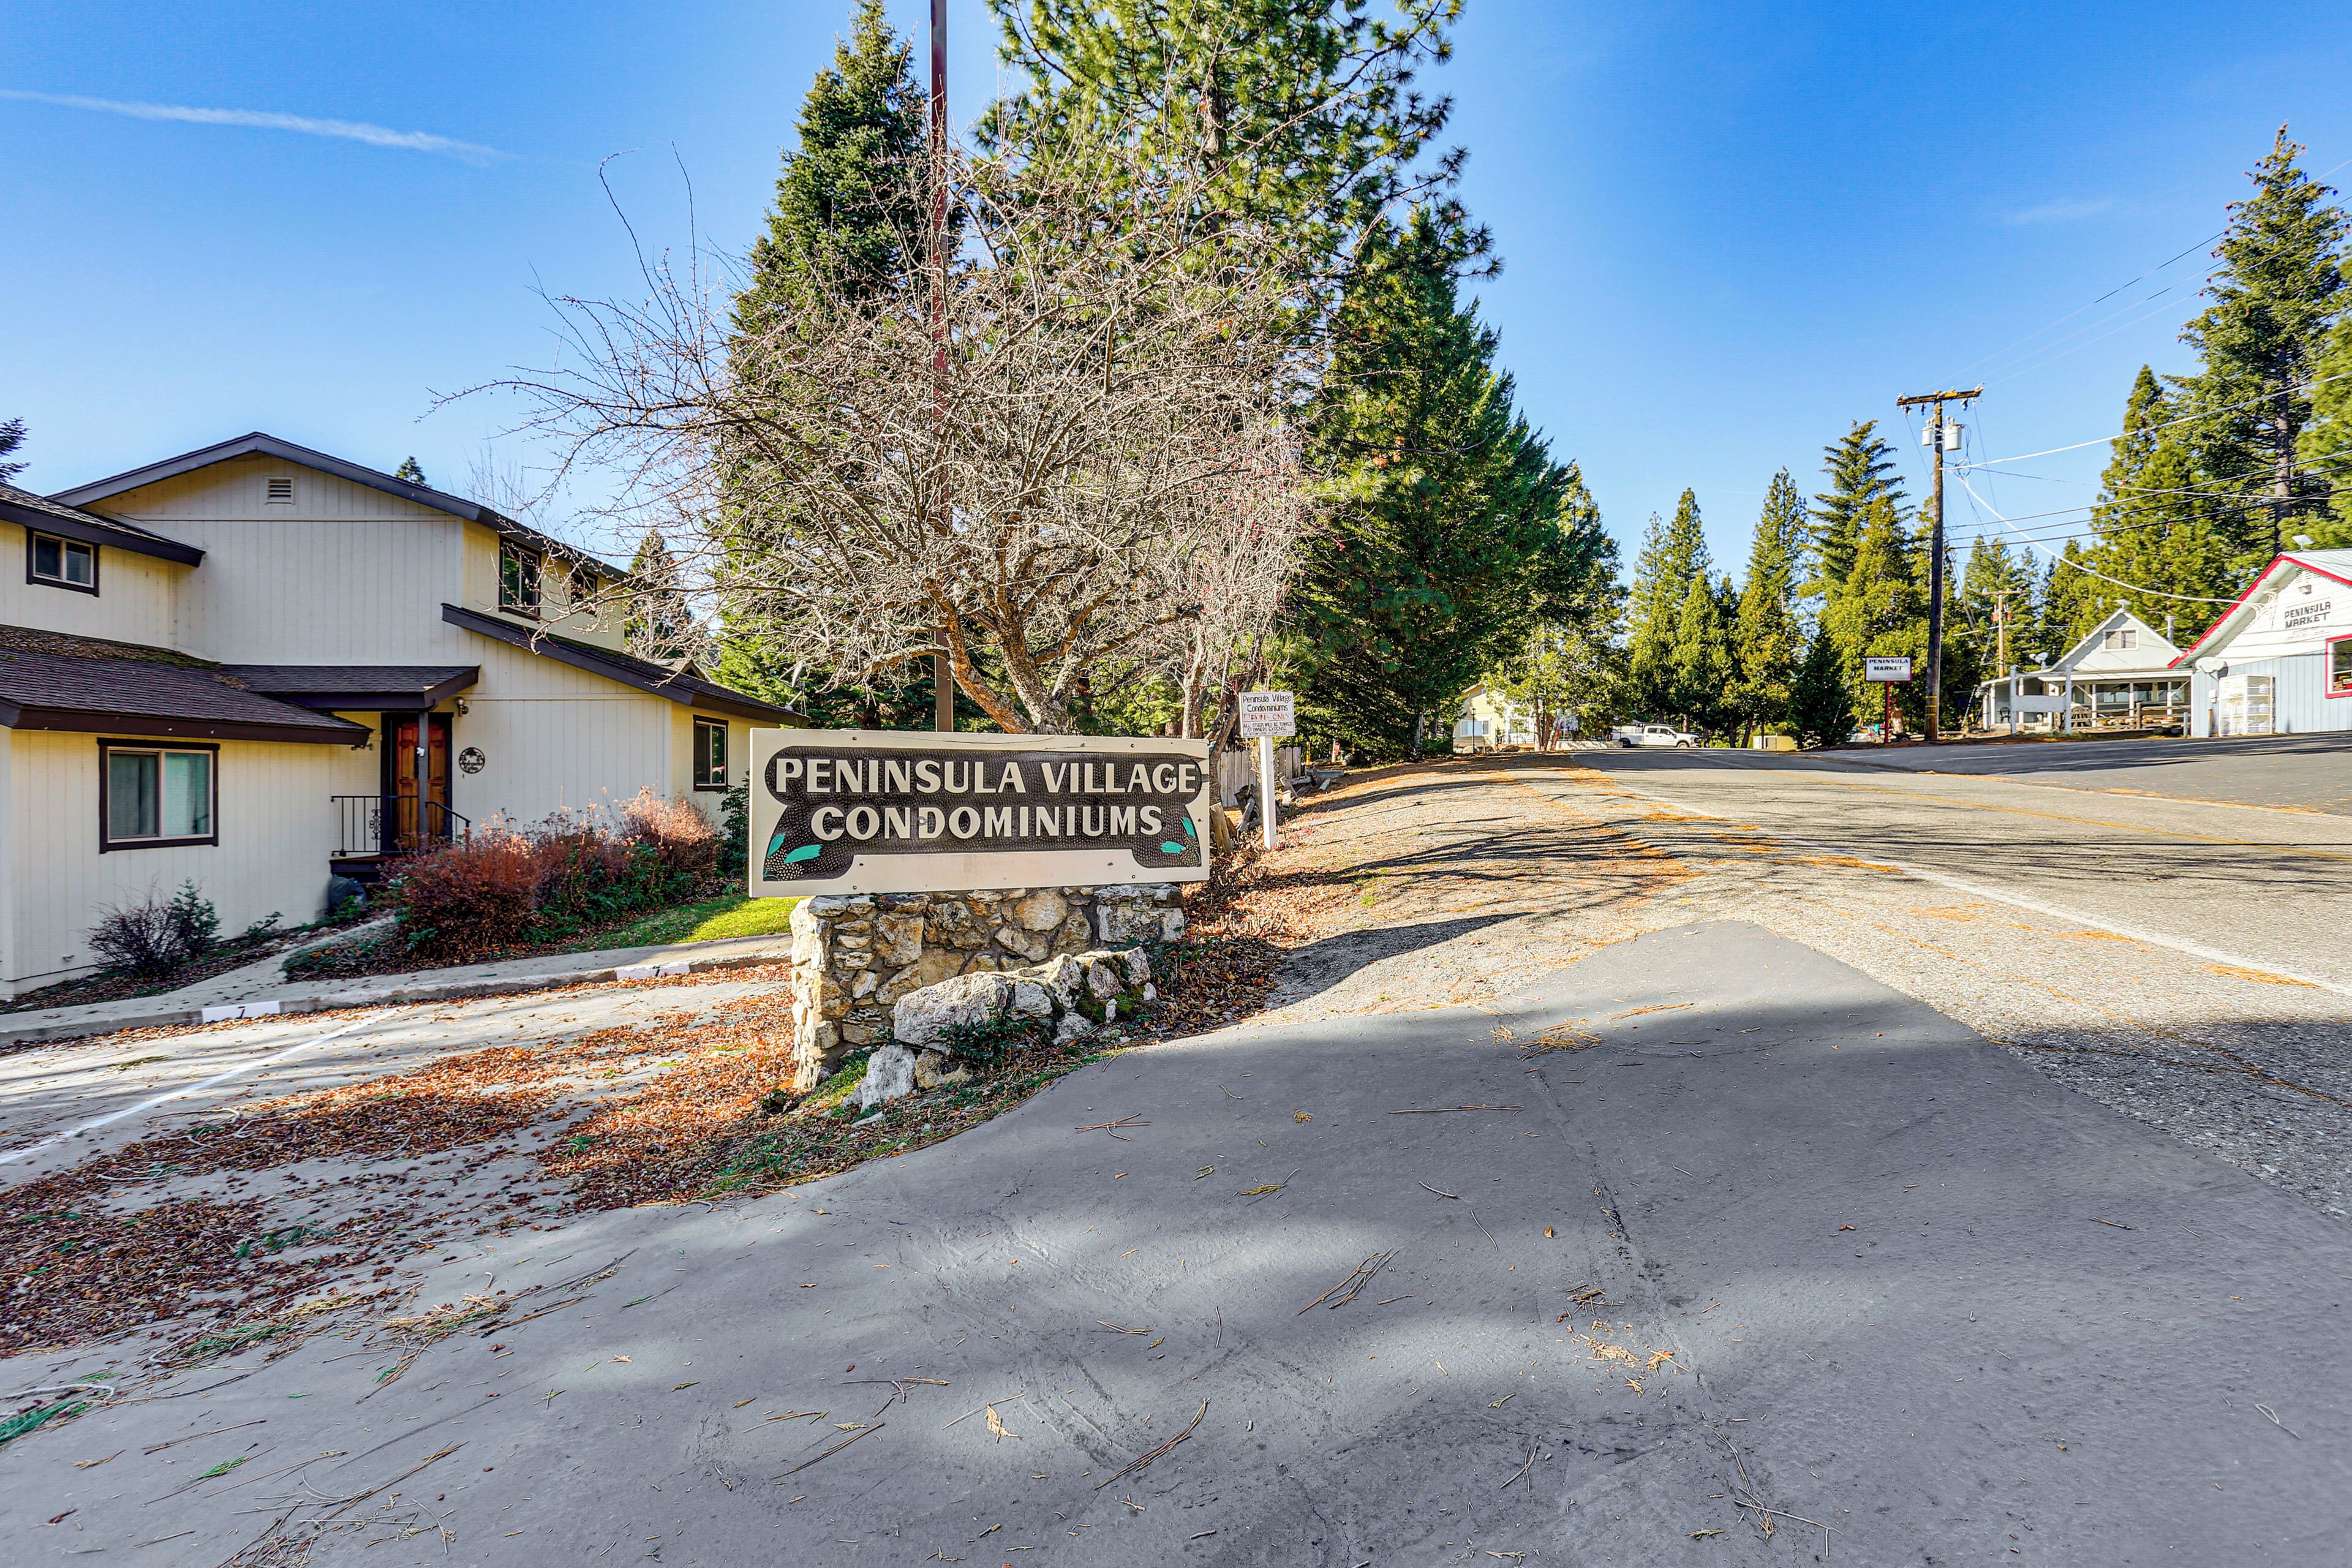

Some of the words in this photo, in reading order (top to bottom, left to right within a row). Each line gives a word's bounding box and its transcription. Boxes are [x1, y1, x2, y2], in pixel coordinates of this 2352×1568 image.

[2285, 601, 2331, 619] PENINSULA
[2285, 612, 2330, 628] MARKET
[1243, 695, 1269, 703] Peninsula
[1272, 694, 1291, 704] Village
[1247, 704, 1288, 712] Condominiums
[775, 758, 1027, 794] PENINSULA
[1041, 762, 1196, 794] VILLAGE
[811, 806, 1163, 841] CONDOMINIUMS
[238, 1006, 245, 1018] 7
